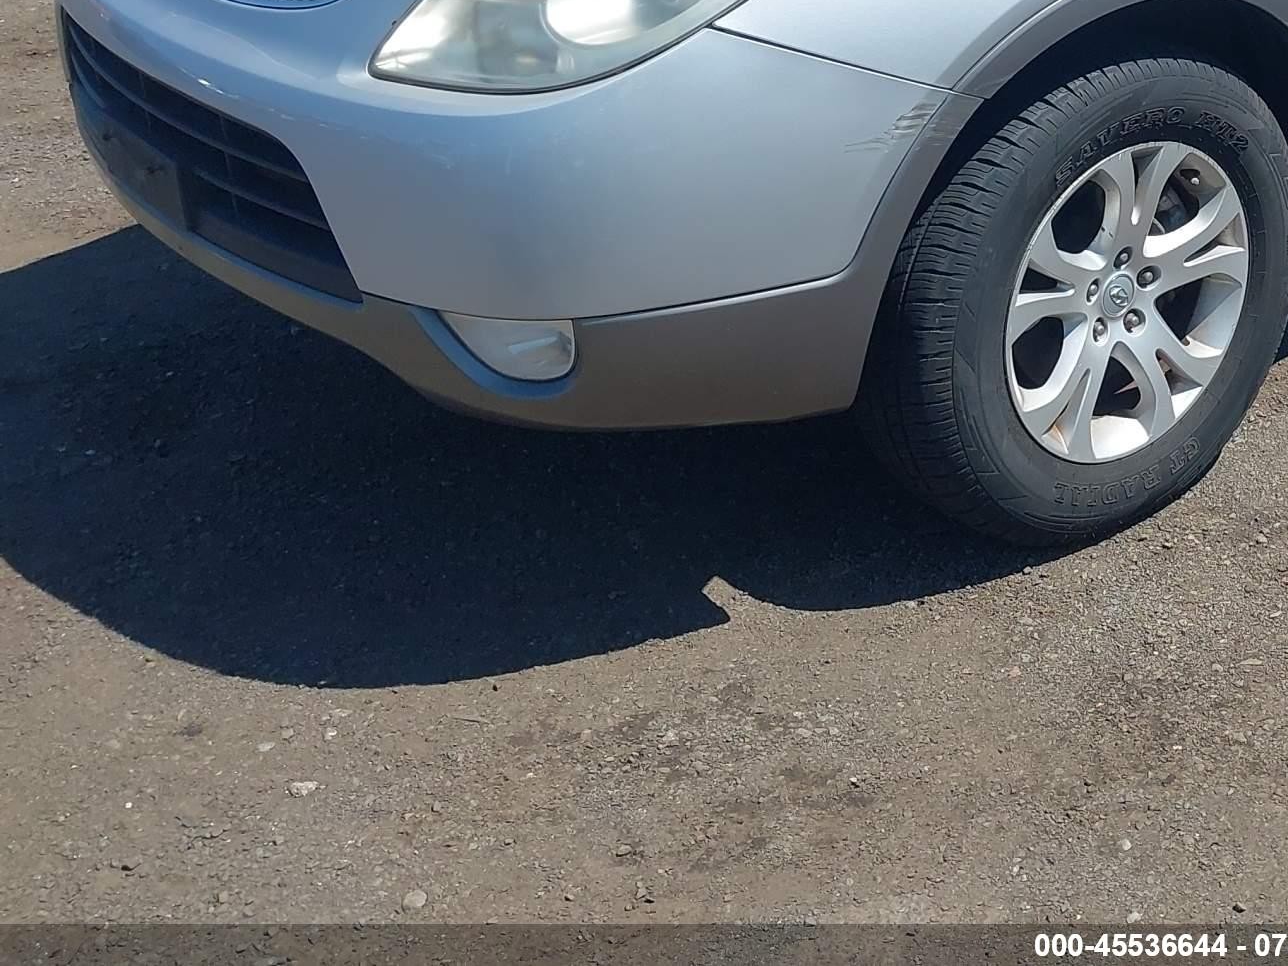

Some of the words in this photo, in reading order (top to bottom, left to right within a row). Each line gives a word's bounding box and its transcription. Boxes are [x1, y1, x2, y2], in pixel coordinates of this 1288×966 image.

[1055, 106, 1185, 185] SAVERO
[1170, 436, 1201, 474] GT
[1054, 465, 1161, 506] RADIAL
